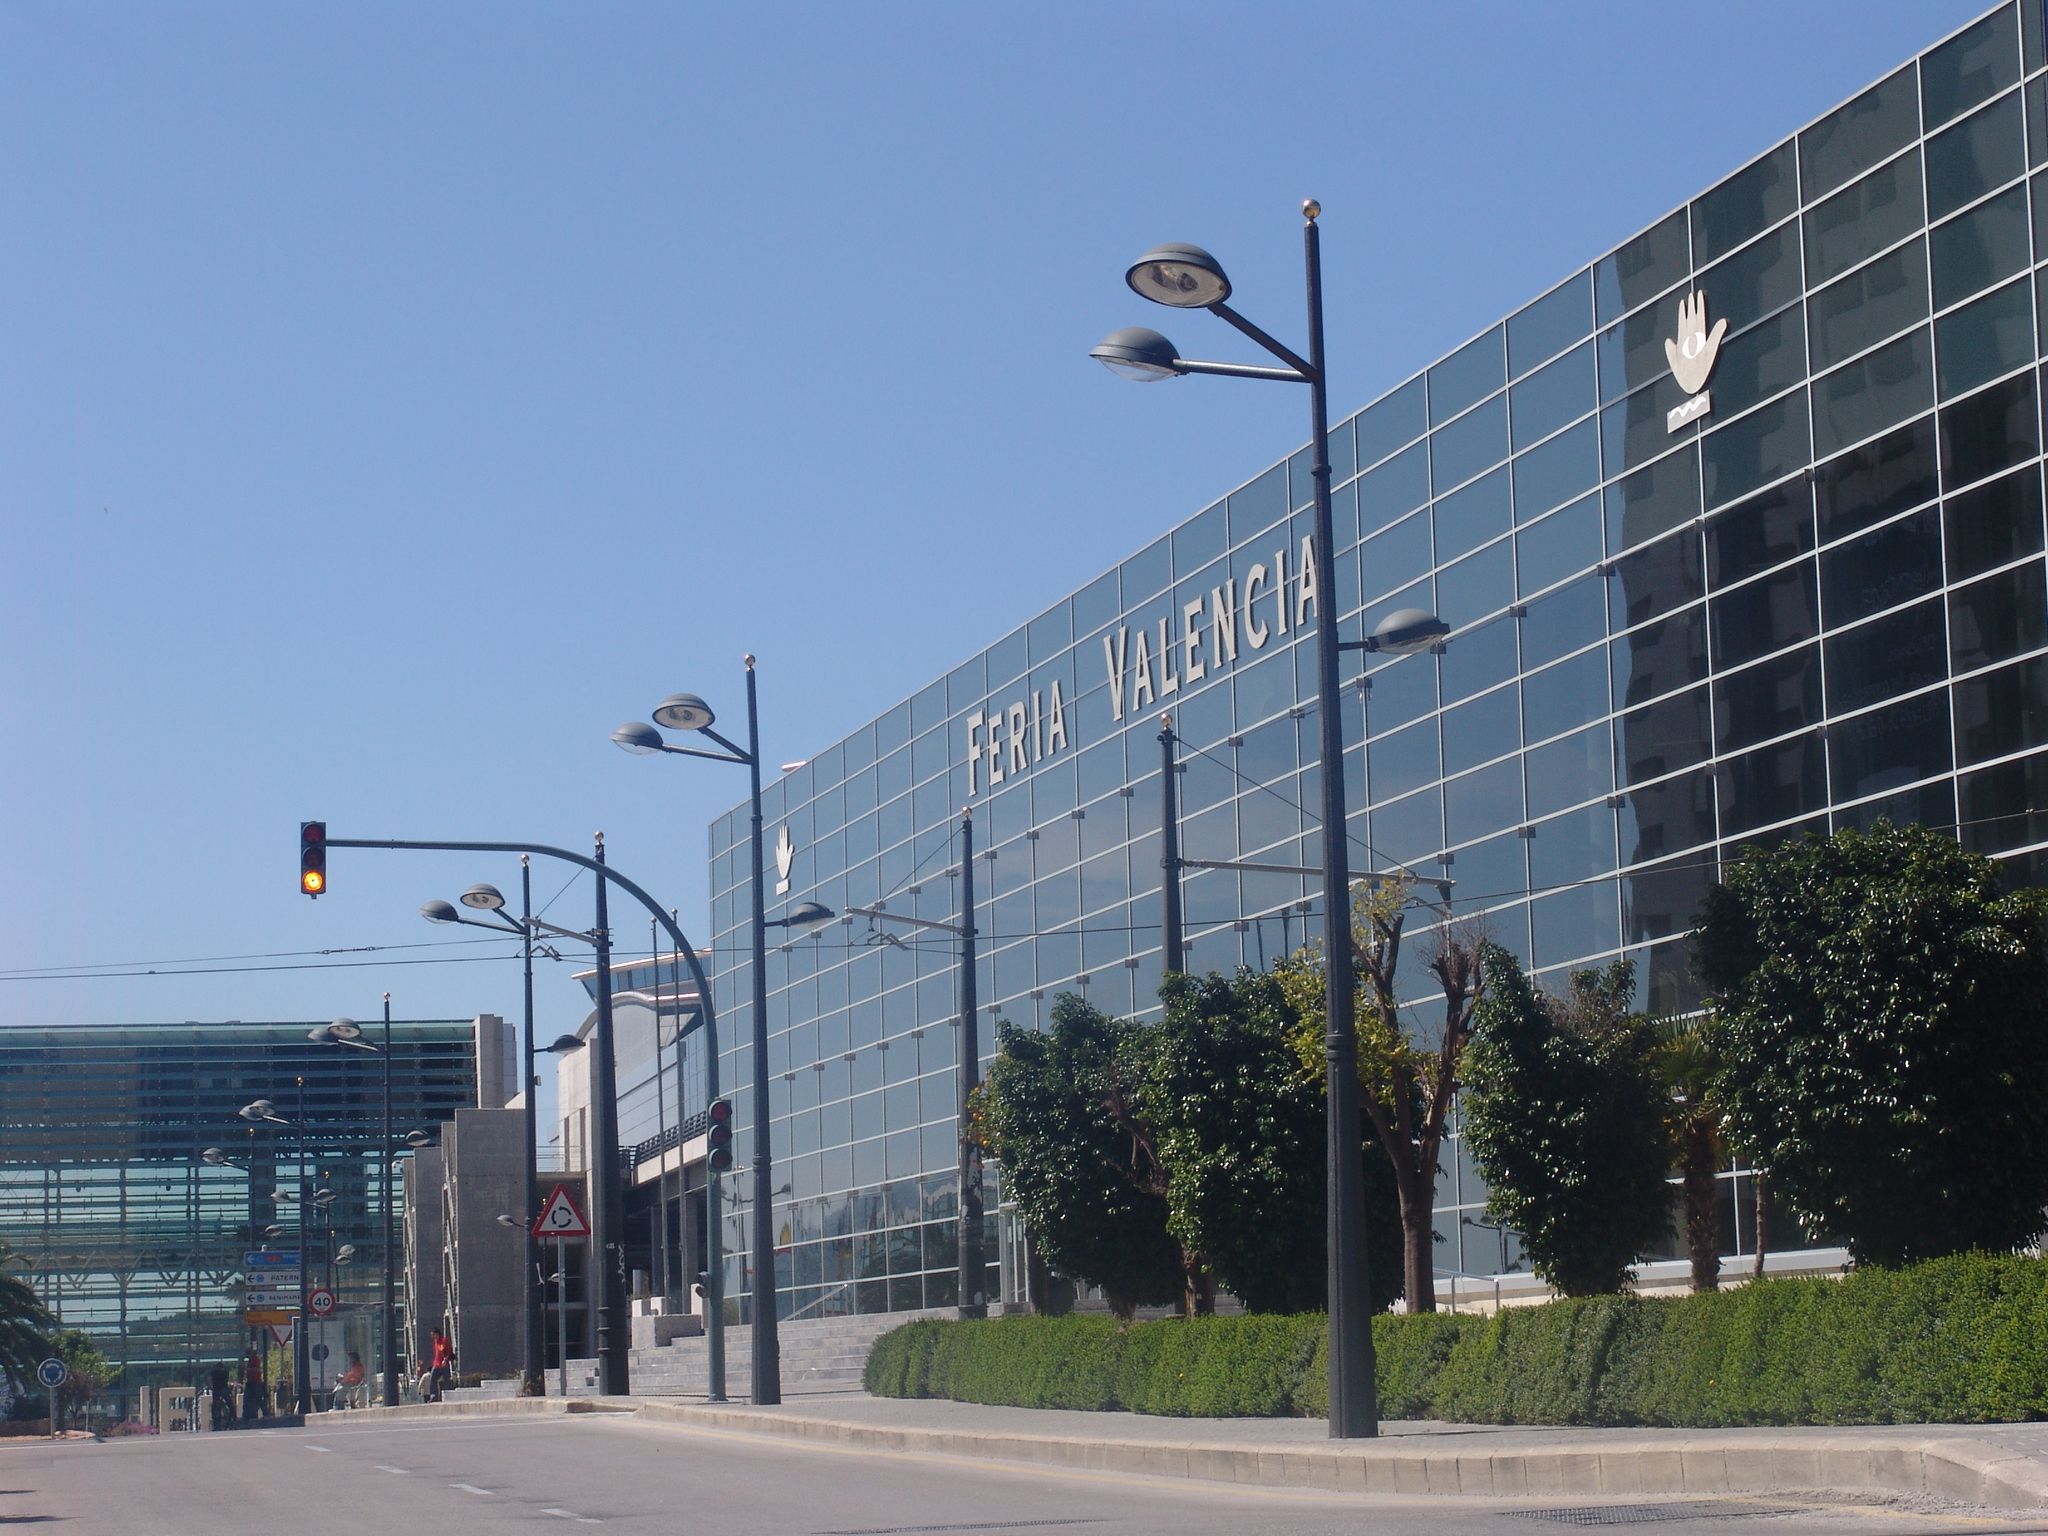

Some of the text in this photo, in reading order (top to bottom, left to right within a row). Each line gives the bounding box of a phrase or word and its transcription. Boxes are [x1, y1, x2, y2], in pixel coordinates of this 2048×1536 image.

[967, 535, 1317, 796] FERIA VALENCIA
[271, 1274, 300, 1282] PATERN
[314, 1297, 331, 1306] 40
